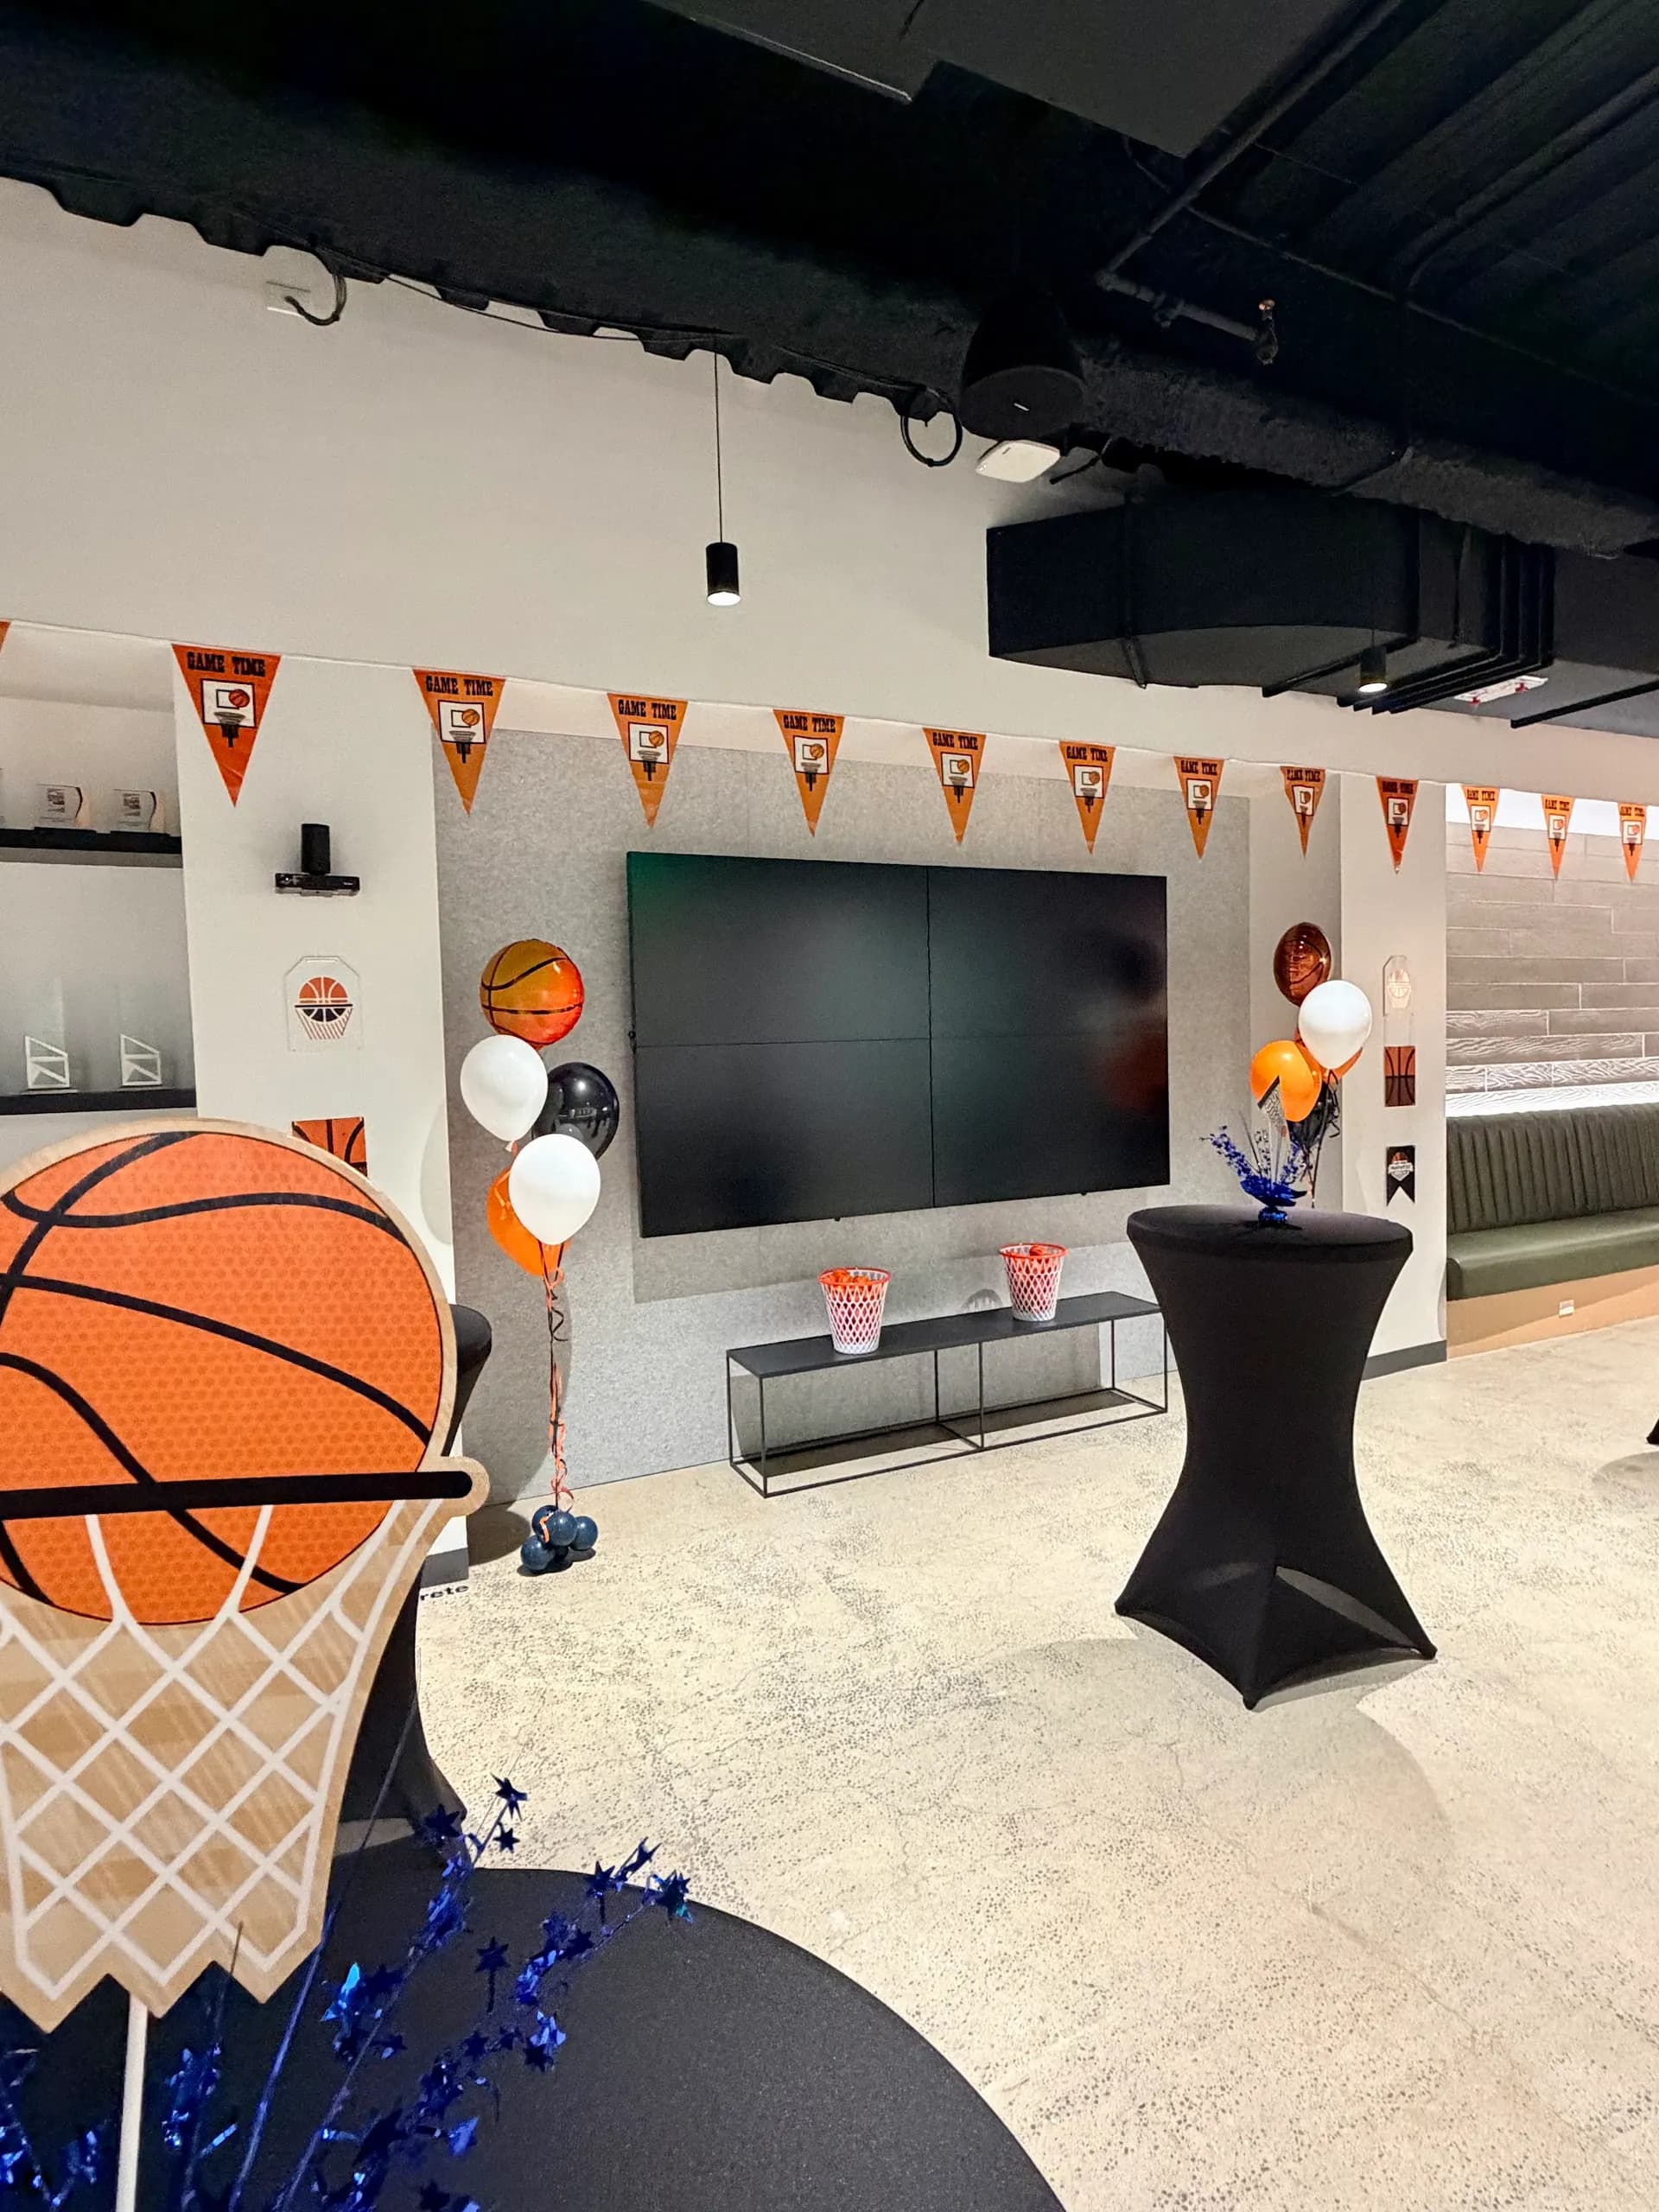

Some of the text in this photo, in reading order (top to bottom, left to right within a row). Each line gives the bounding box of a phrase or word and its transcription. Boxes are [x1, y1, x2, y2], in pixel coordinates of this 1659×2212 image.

[187, 652, 265, 677] GAME TIME
[426, 675, 493, 696] GAME TIME
[618, 699, 677, 721] GAME TIME
[783, 715, 836, 734] GAME TIME
[932, 732, 978, 750] GAME TIME
[420, 1586, 469, 1600] rete
